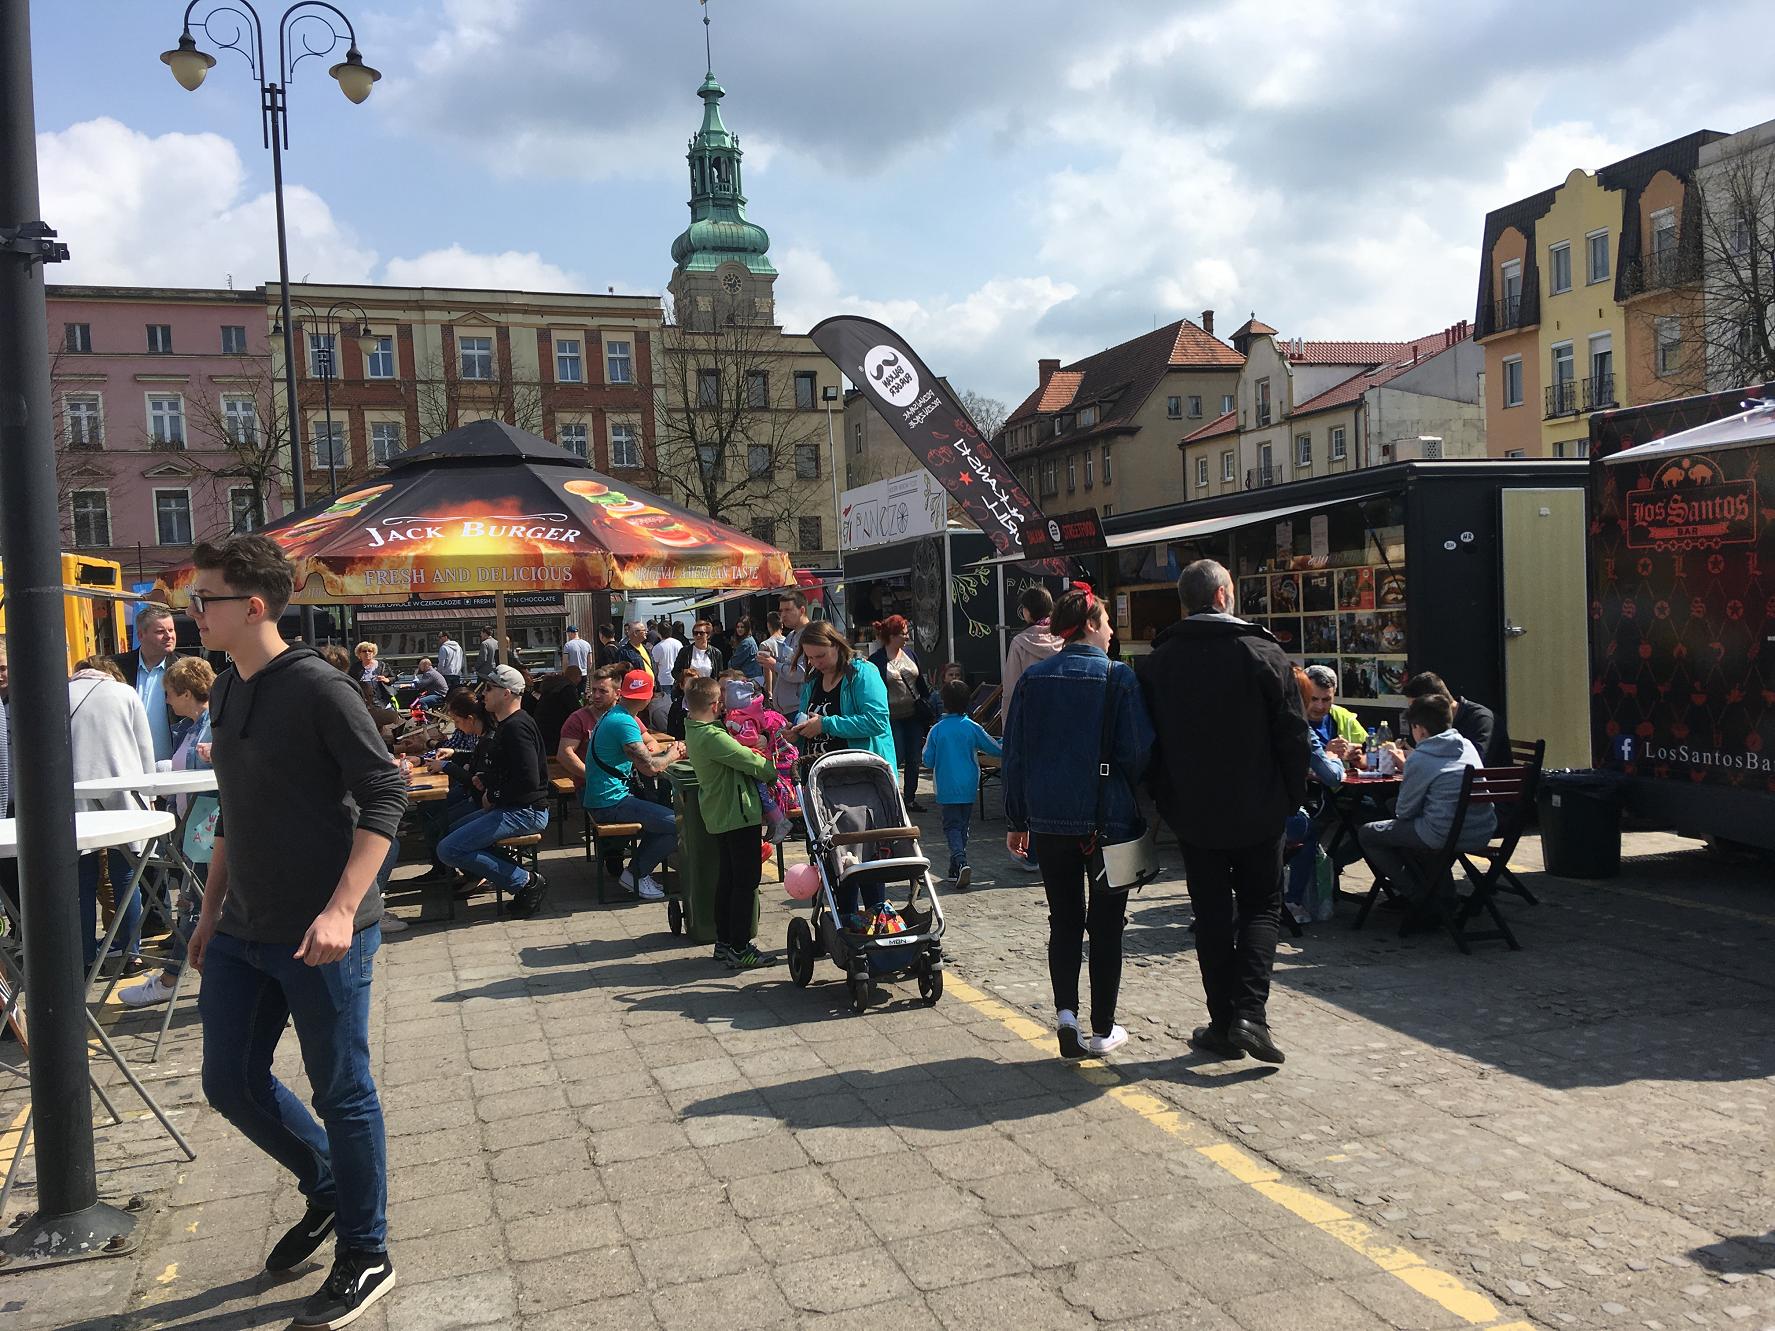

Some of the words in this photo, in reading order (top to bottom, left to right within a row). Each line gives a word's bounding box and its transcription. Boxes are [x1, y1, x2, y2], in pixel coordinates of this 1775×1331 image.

[1666, 494, 1749, 525] Santos
[365, 526, 445, 547] JACK
[460, 521, 581, 543] BURGER
[1677, 528, 1698, 536] BAR
[364, 568, 426, 586] FRESH
[432, 567, 471, 583] AND
[477, 566, 573, 583] DELICIOUS
[731, 566, 760, 580] TASTE
[520, 595, 556, 603] CHOCOLATE
[1645, 742, 1775, 771] LosSantosBa
